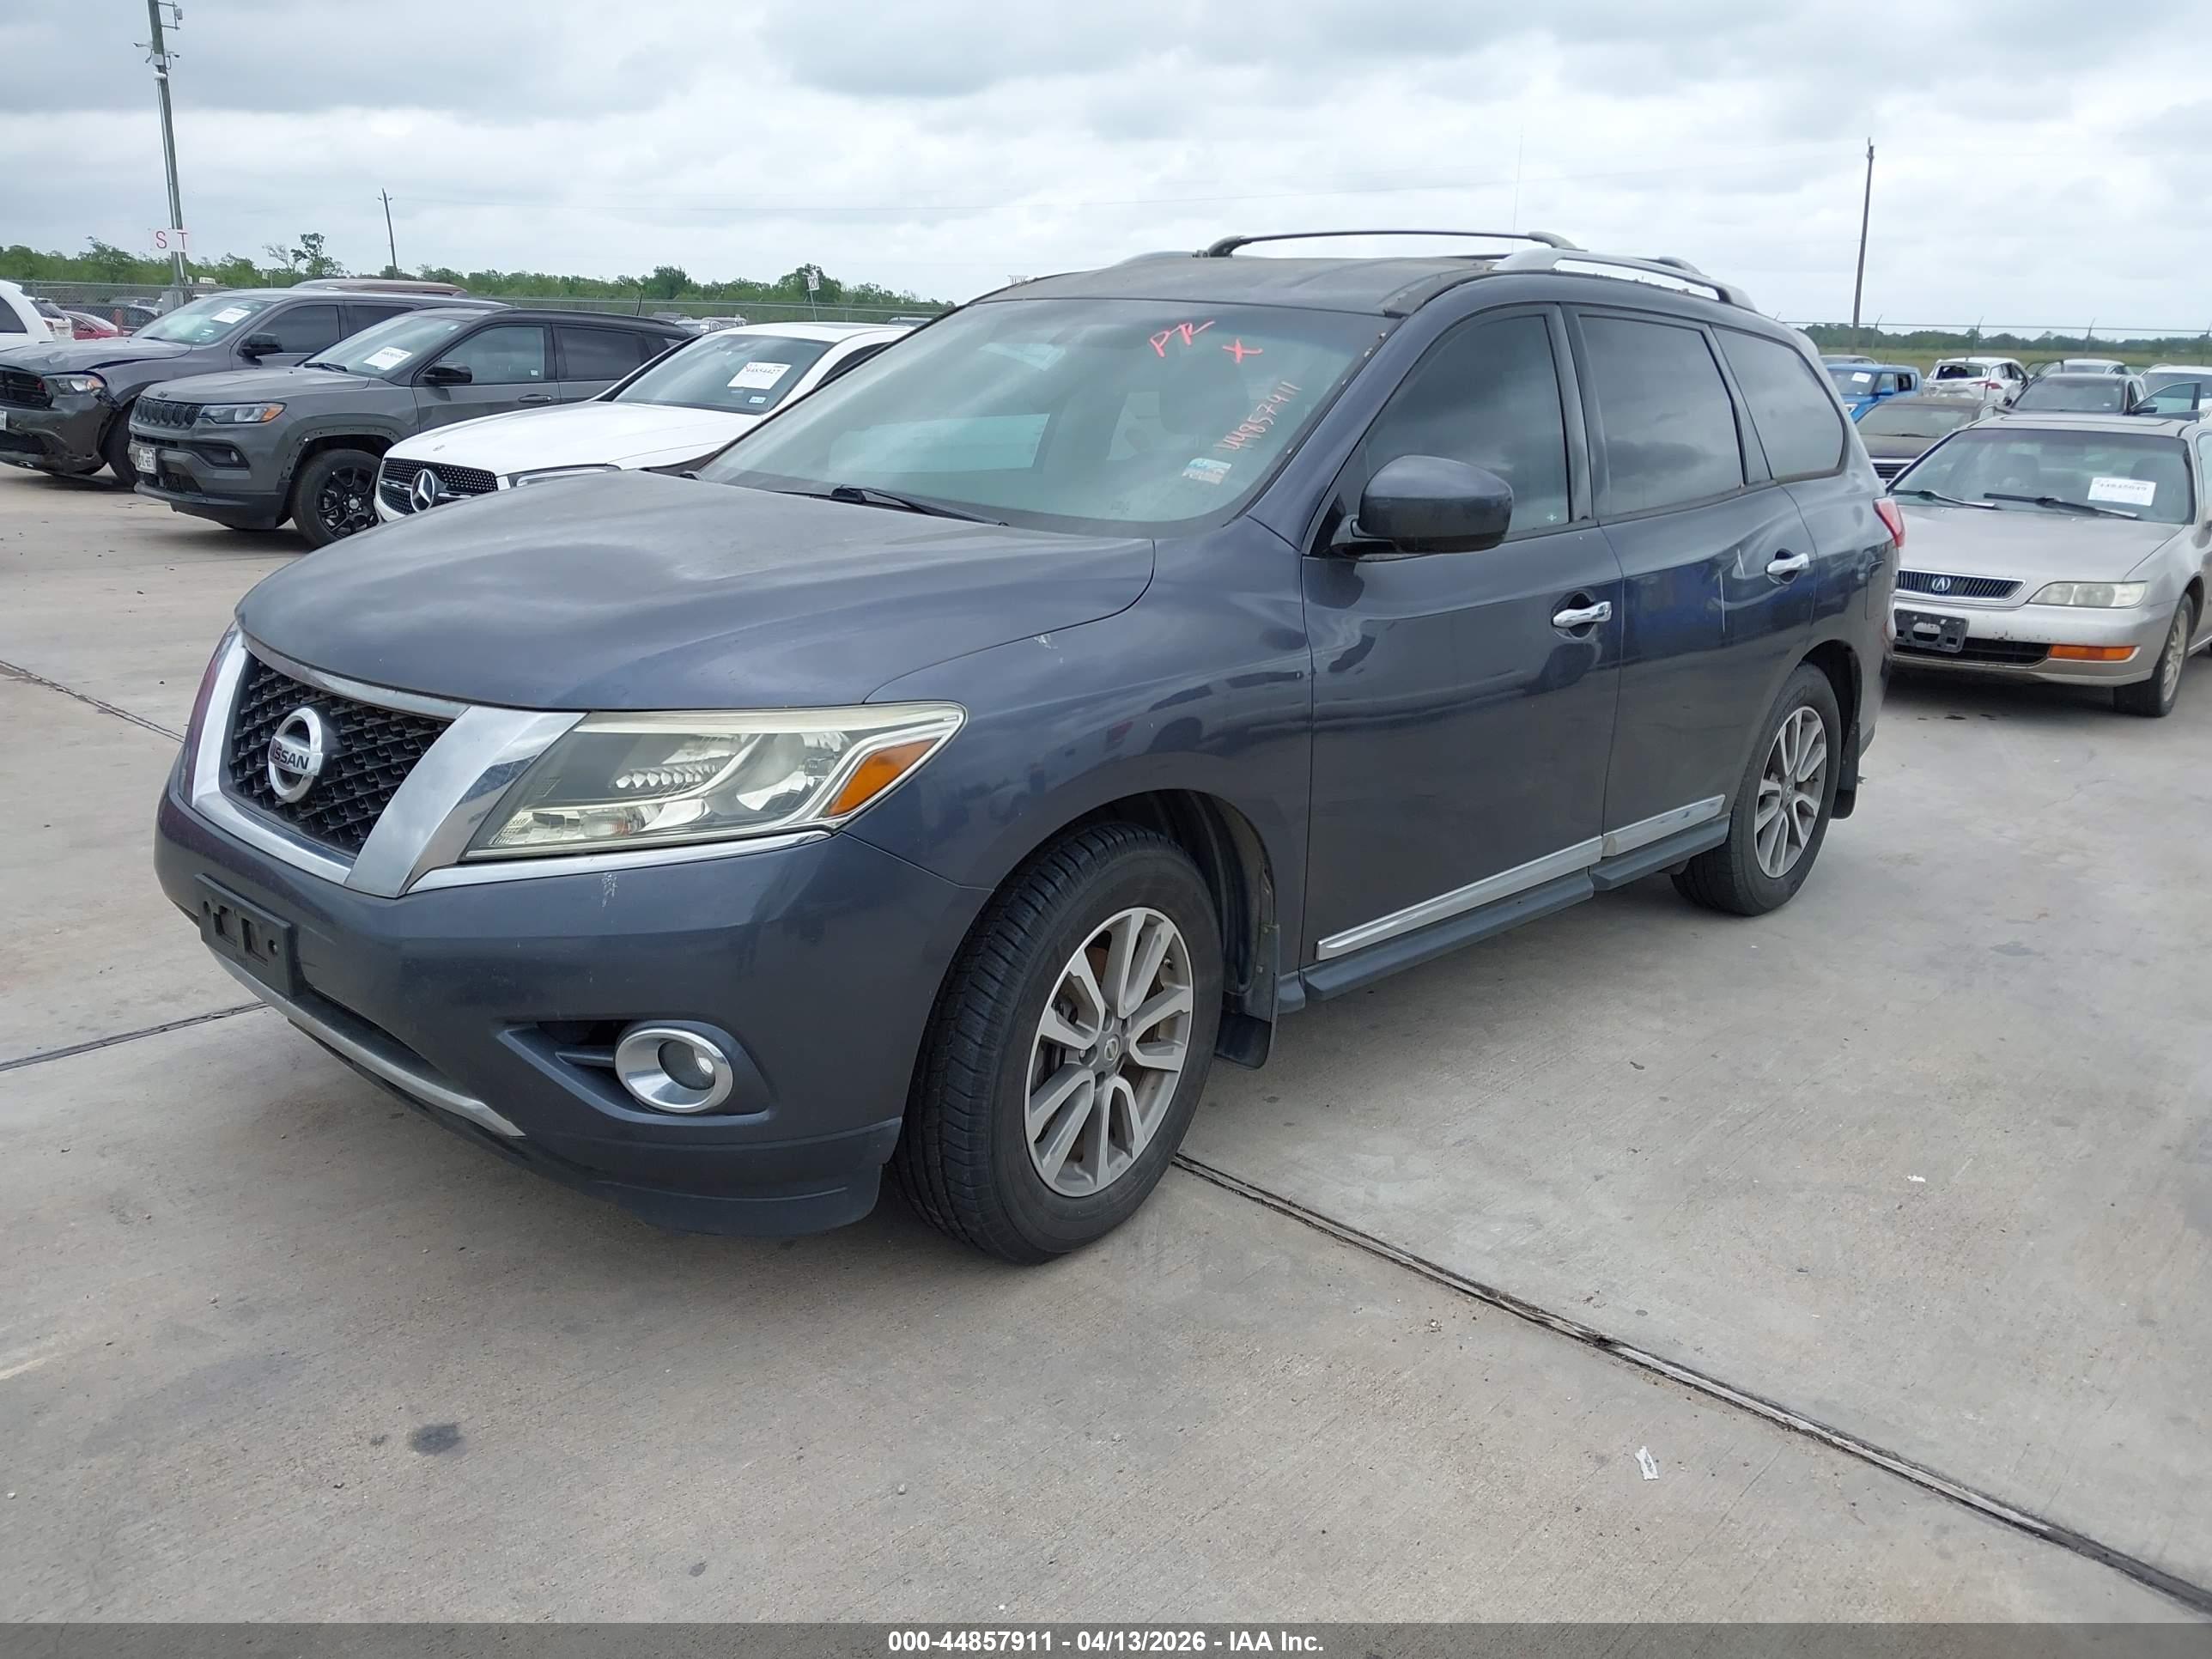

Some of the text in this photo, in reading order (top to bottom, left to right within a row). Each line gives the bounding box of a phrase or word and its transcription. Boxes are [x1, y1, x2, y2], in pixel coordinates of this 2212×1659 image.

[155, 230, 189, 250] S T
[809, 277, 818, 289] 20
